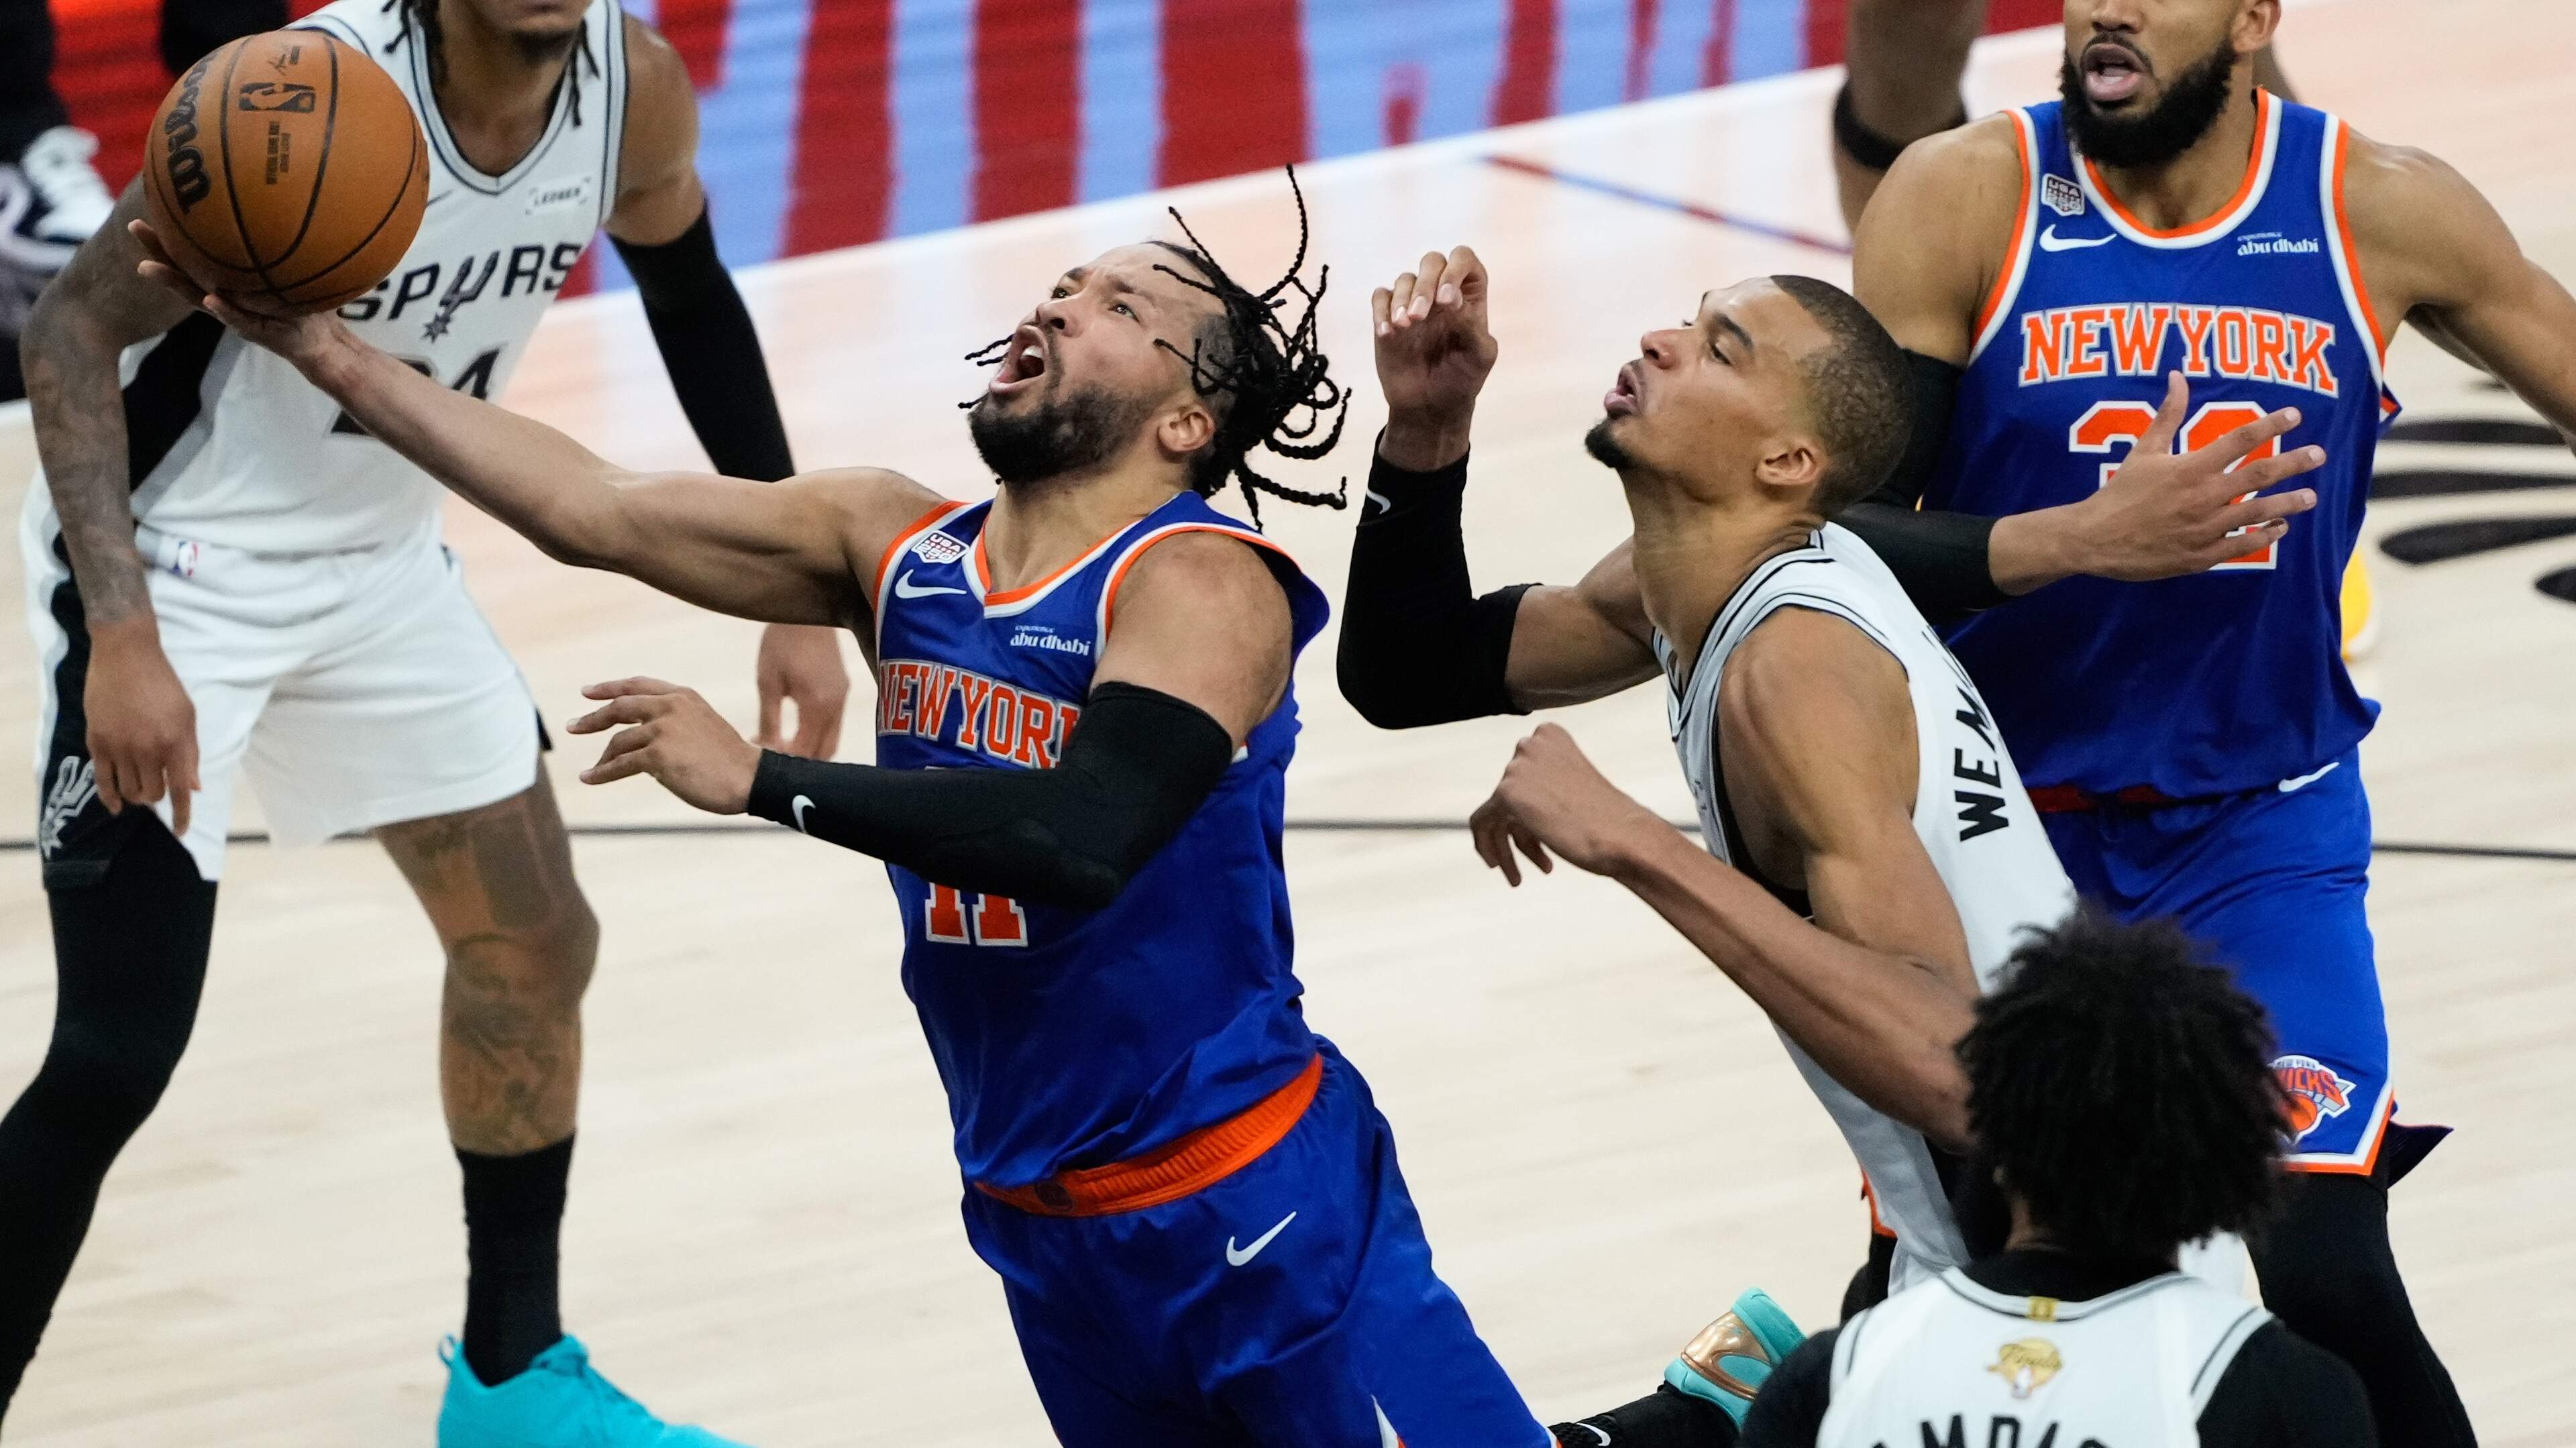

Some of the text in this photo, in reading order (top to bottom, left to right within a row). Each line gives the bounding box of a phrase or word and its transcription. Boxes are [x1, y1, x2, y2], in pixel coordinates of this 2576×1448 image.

[2237, 237, 2319, 256] abu dhabi
[2018, 302, 2339, 398] NEW YORK
[1010, 632, 1091, 656] abu dhabi
[877, 659, 956, 742] NEW
